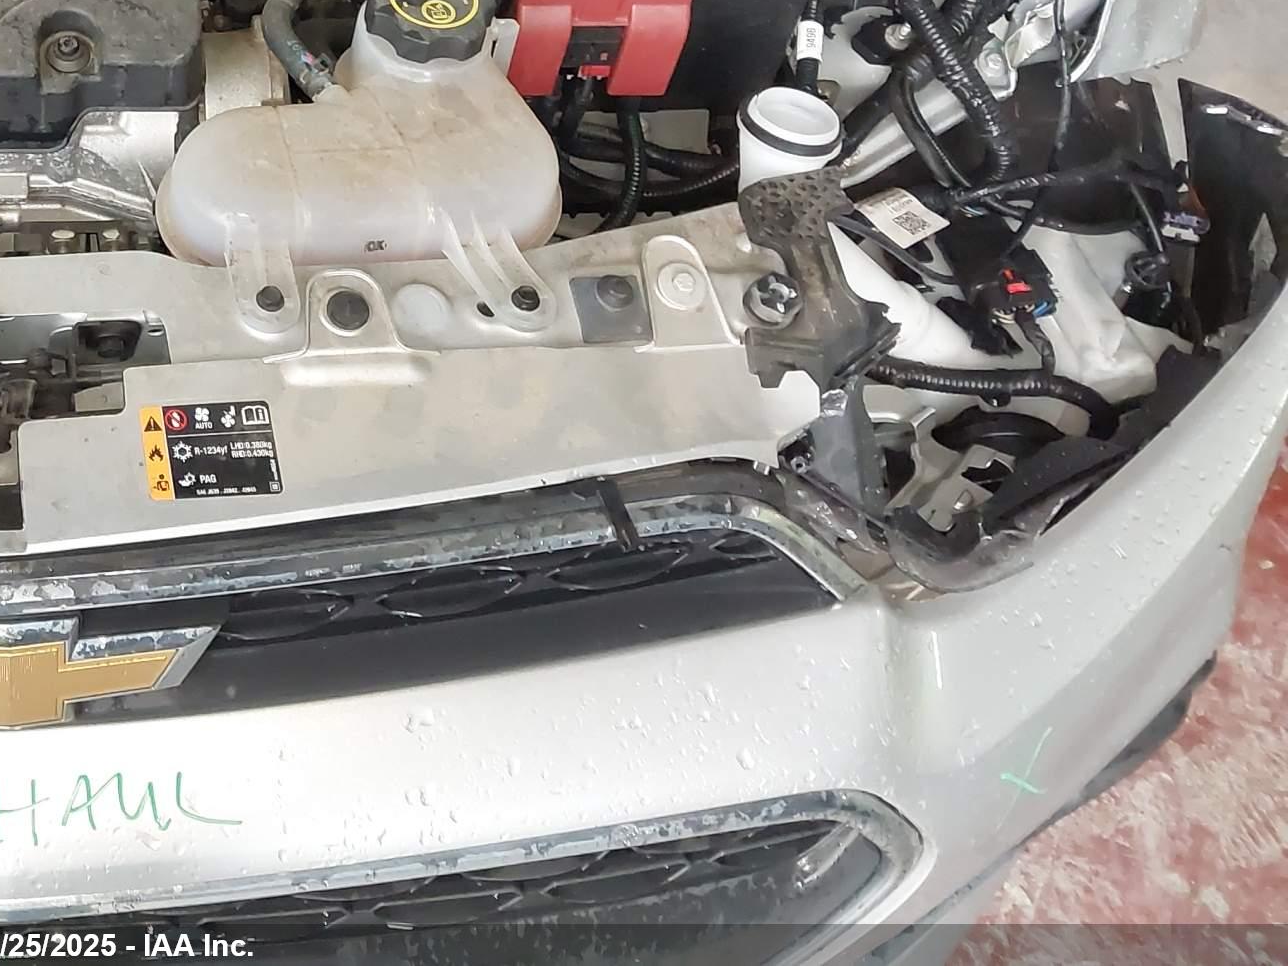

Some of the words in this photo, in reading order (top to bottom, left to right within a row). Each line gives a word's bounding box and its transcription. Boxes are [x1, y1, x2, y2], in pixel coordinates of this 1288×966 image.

[195, 421, 213, 430] AUTO
[194, 446, 229, 457] R-1234yf
[199, 474, 217, 484] PAG
